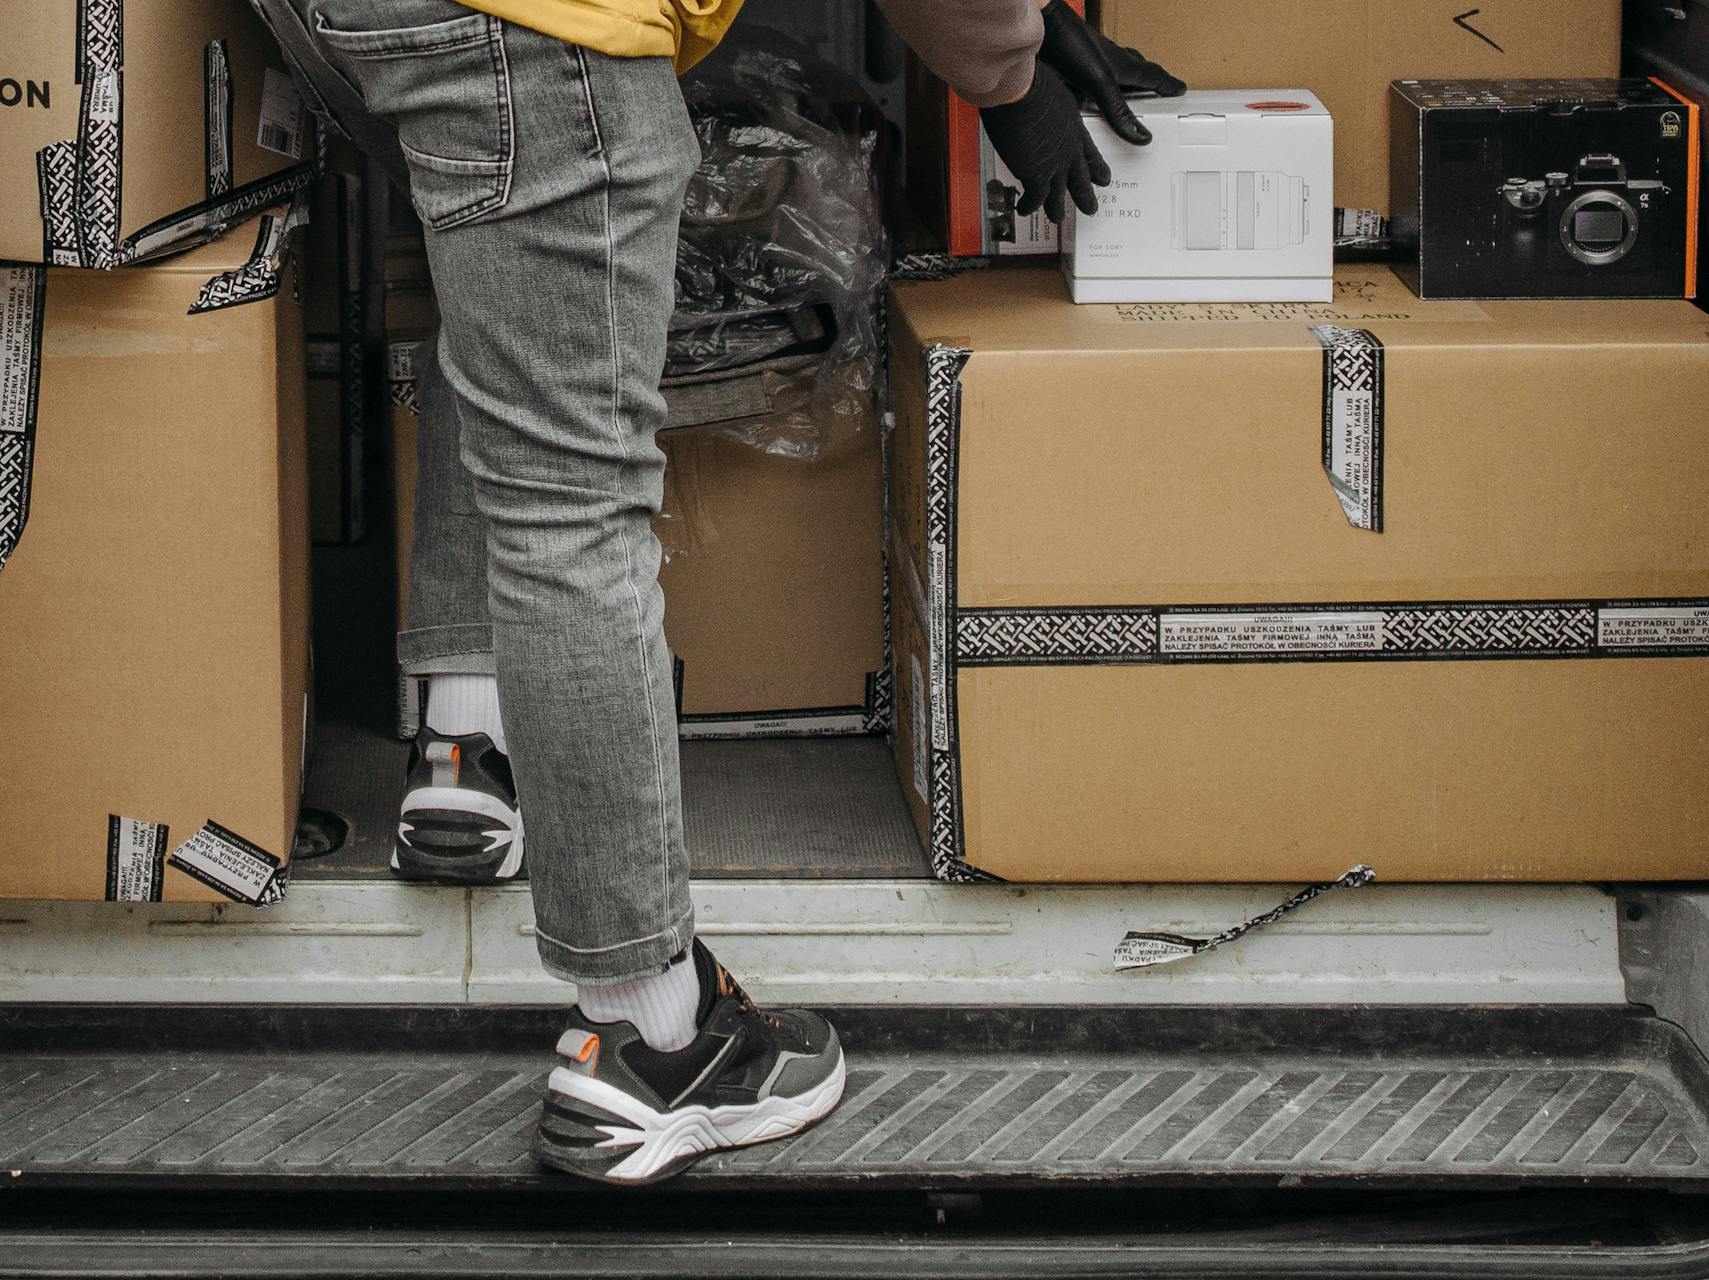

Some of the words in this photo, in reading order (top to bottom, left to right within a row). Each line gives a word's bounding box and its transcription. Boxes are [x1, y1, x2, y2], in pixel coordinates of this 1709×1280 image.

[0, 77, 51, 109] ON
[1119, 209, 1142, 218] RXD
[71, 255, 78, 265] W
[6, 286, 17, 351] USZKODZENIA
[15, 287, 25, 334] FIRMOWEJ
[25, 313, 32, 321] W
[1308, 313, 1411, 321] POLAND
[12, 340, 21, 369] TAŚMY
[21, 322, 32, 371] PROTOKÓŁ
[2, 357, 12, 412] PRZYPADKU
[19, 371, 28, 398] SPISAĆ
[7, 374, 19, 428] ZAKLEJENIA
[16, 397, 26, 428] NALEŻY
[1354, 397, 1362, 428] TAŚMĄ
[1362, 398, 1370, 435] KURIERA
[1354, 434, 1362, 457] INNĄ
[1362, 487, 1369, 495] W
[936, 550, 944, 586] KURIERA
[1164, 626, 1173, 634] W
[1180, 625, 1237, 634] PRZYPADKU
[1243, 624, 1312, 633] USZKODZENIA
[1318, 623, 1350, 632] TAŚMY
[1356, 624, 1376, 632] LUB
[1602, 628, 1659, 636] ZAKLEJENIA
[1665, 627, 1696, 635] TAŚMY
[1618, 619, 1676, 628] PRZYPADKU
[1164, 634, 1221, 642] ZAKLEJENIA
[1227, 632, 1256, 641] TAŚMY
[1262, 633, 1310, 641] FIRMOWEJ
[1316, 633, 1338, 641] INNĄ
[1345, 631, 1377, 641] TAŚMĄ
[1164, 642, 1197, 650] NALEŻY
[1199, 641, 1229, 650] SPISAĆ
[1230, 641, 1276, 650] PROTOKÓŁ
[1277, 641, 1285, 649] W
[1338, 639, 1376, 648] KURIERA
[1602, 636, 1635, 645] NALEŻY
[1638, 635, 1668, 644] SPISAĆ
[138, 829, 148, 848] INNĄ
[214, 839, 242, 857] SPISAĆ
[133, 852, 144, 895] FIRMOWEJ
[200, 850, 249, 881] PRZYPADKU
[218, 850, 266, 881] ZAKLEJENIA
[242, 854, 270, 873] NALEŻY
[143, 874, 150, 883] W
[252, 880, 261, 889] W
